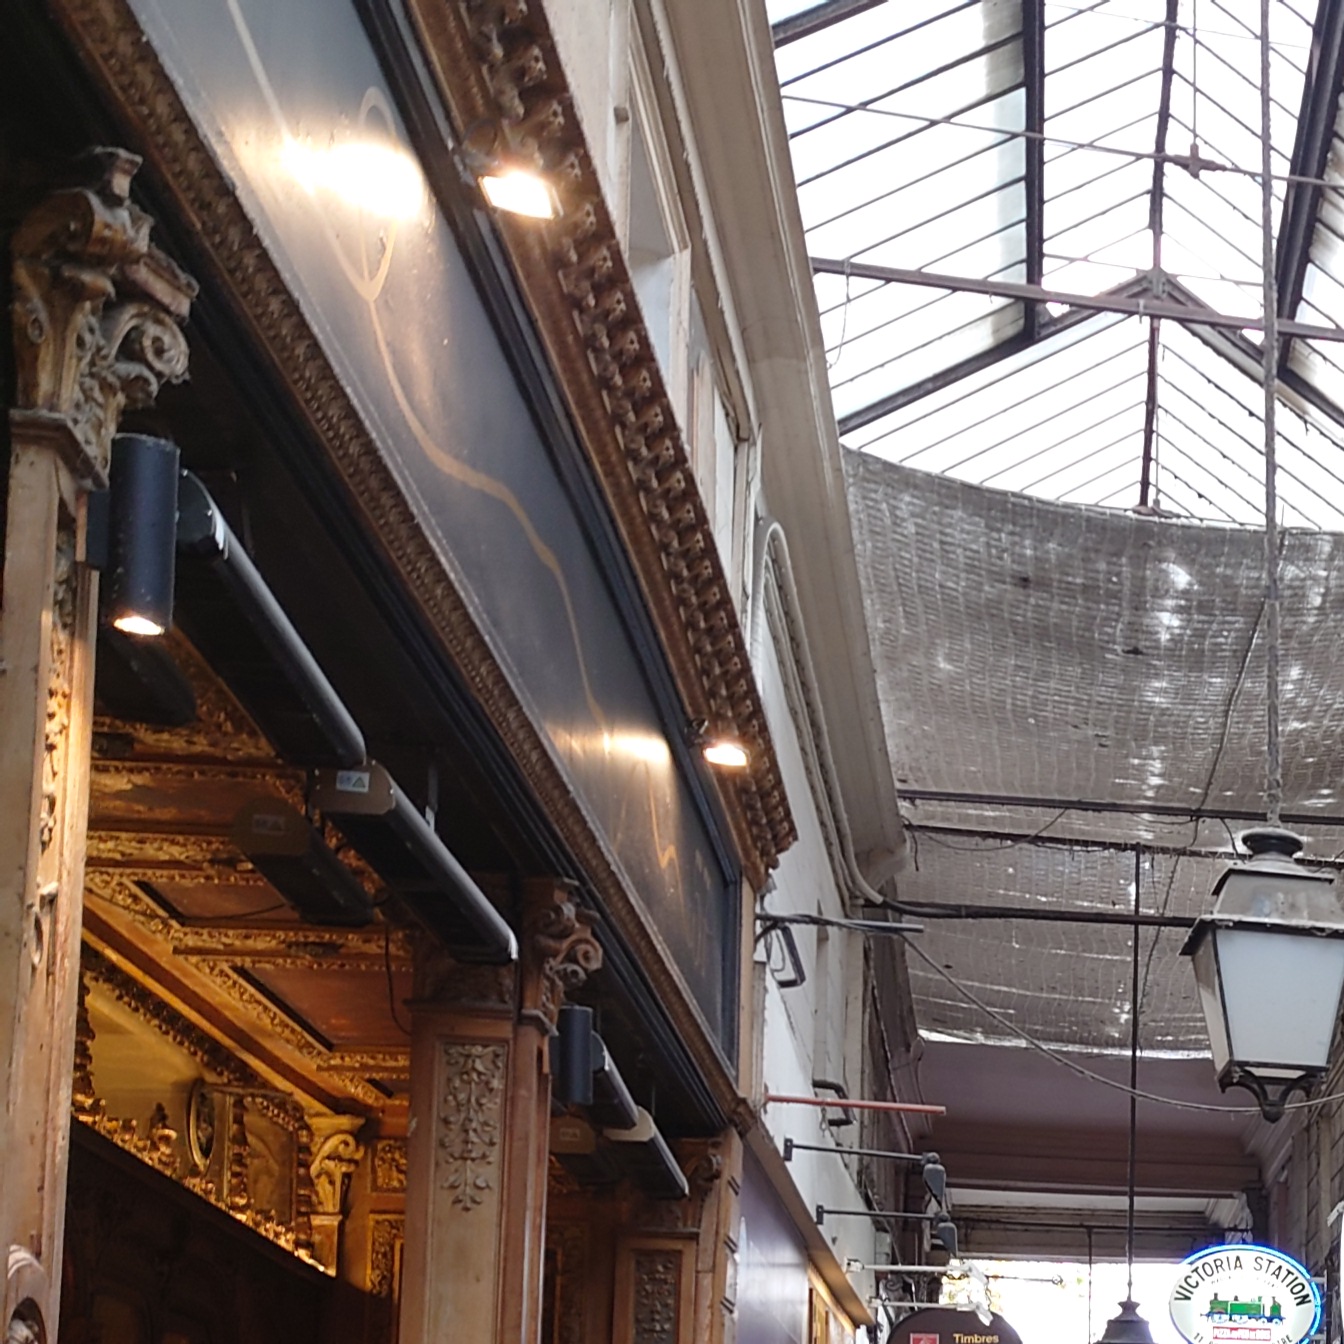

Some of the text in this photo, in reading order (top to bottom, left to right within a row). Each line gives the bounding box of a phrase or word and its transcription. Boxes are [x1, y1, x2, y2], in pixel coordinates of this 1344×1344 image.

[1174, 1255, 1312, 1307] VICTORIA STATION
[953, 1333, 999, 1344] Timbres
